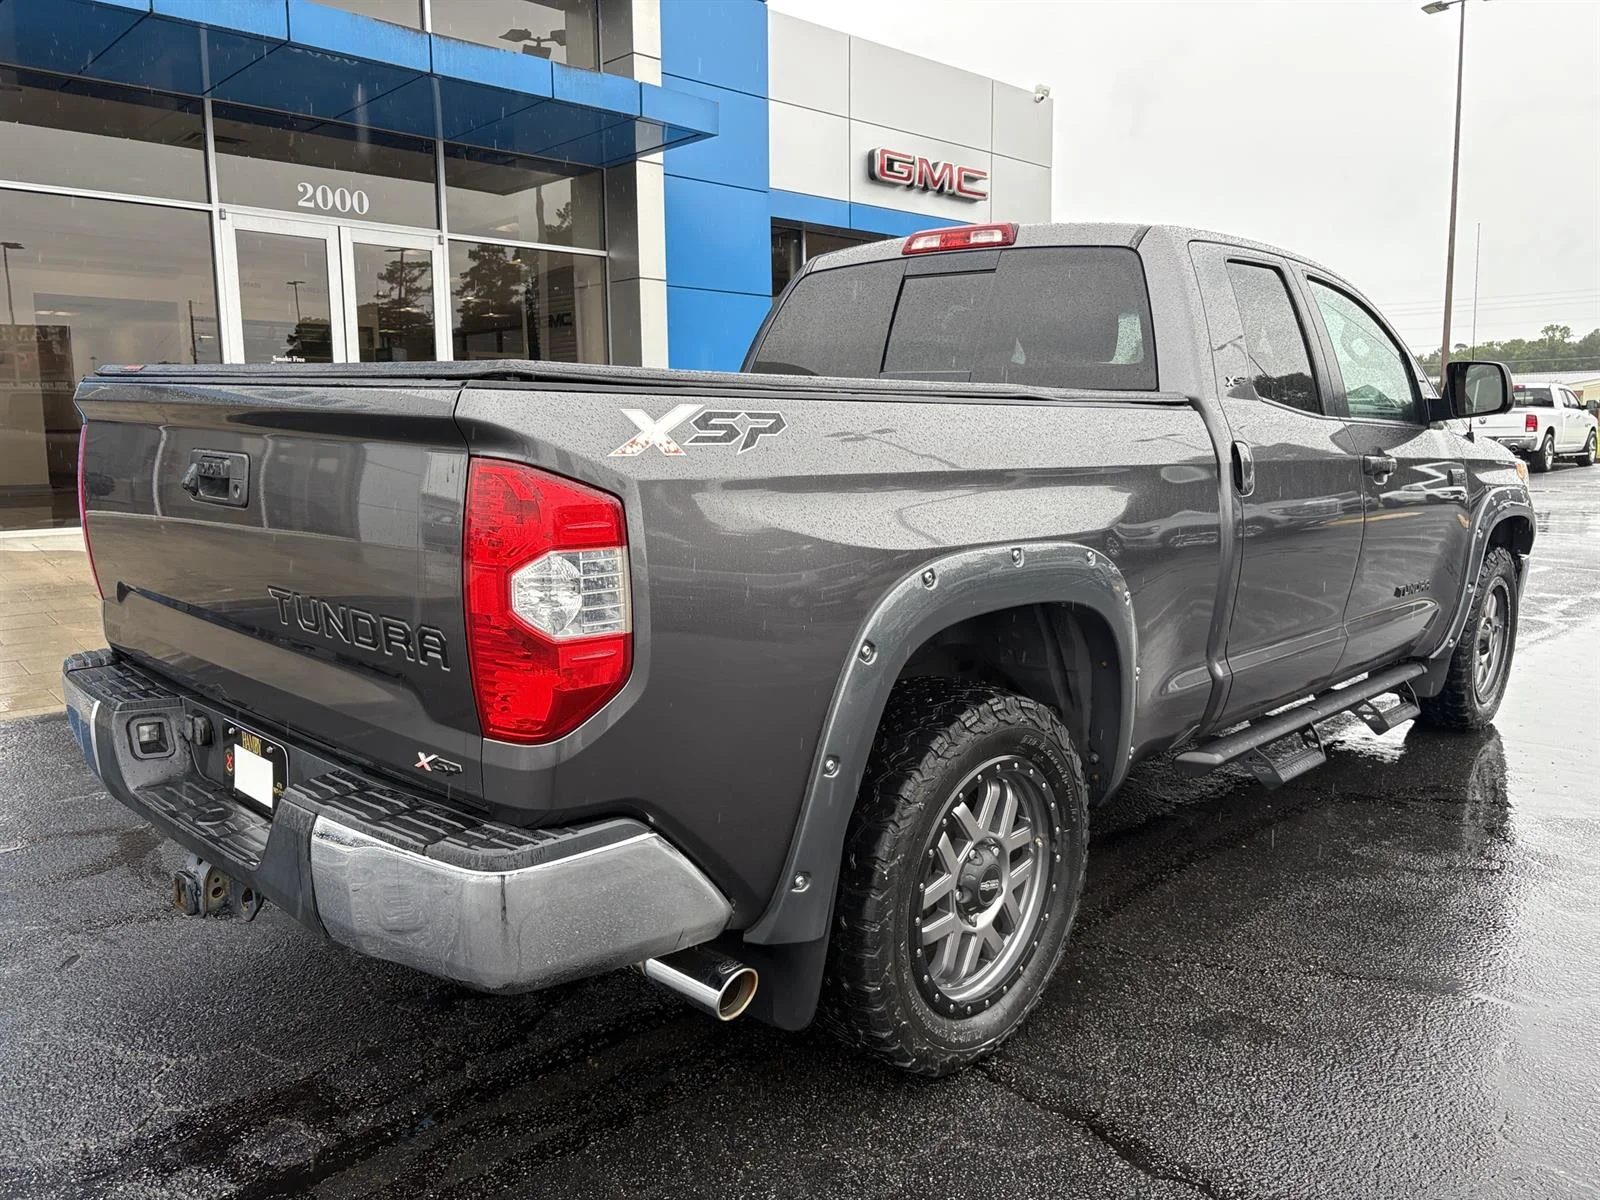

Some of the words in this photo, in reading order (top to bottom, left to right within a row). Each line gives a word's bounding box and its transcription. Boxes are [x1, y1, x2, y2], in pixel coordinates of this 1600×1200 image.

[297, 182, 369, 215] 2000
[869, 147, 989, 201] GMC
[606, 403, 788, 457] XSP
[267, 584, 451, 672] TUNDRA
